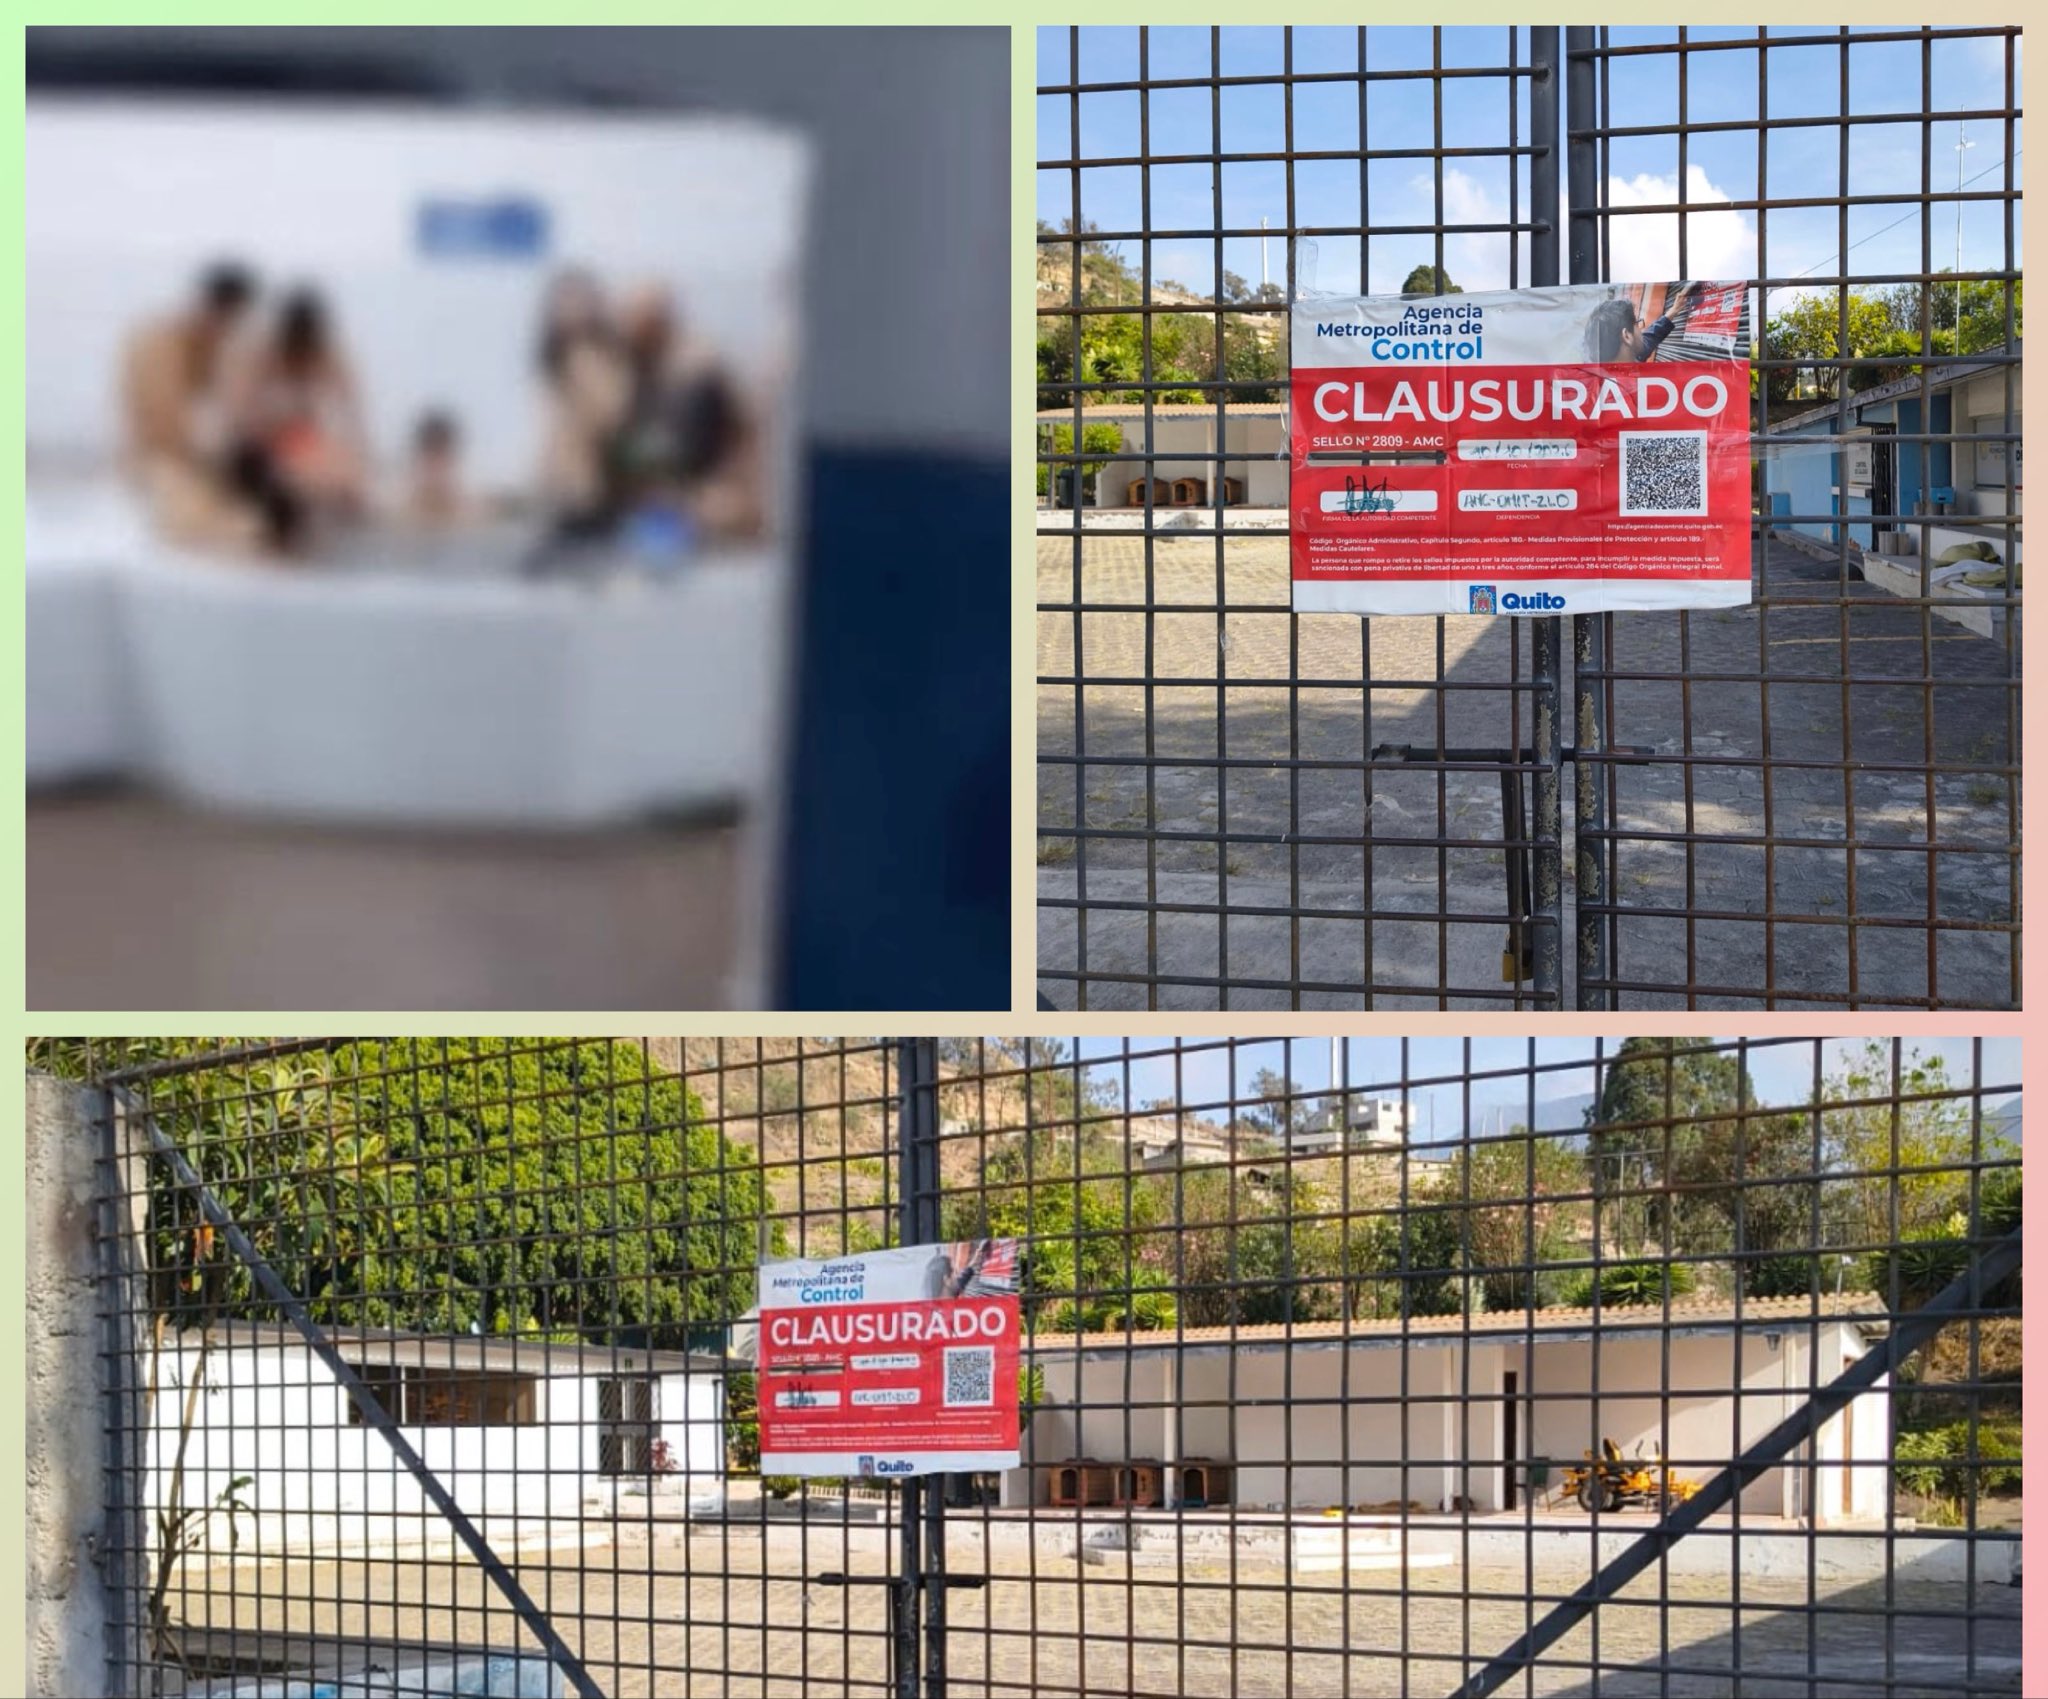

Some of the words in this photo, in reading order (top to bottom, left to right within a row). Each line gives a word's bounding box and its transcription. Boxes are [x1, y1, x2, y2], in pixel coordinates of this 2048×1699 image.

[1403, 303, 1483, 322] Agencia
[1317, 319, 1452, 339] Metropolitana
[1458, 320, 1483, 335] de
[1371, 336, 1482, 361] Control
[1313, 376, 1728, 422] CLAUSURADO
[1313, 436, 1352, 447] SELLO
[1372, 436, 1403, 447] 2809
[1413, 436, 1444, 446] AMC
[1557, 535, 1603, 543] Provisionales
[1501, 592, 1565, 609] Quito
[820, 1261, 865, 1275] Agencia
[850, 1273, 865, 1283] de
[801, 1284, 864, 1303] Control
[770, 1306, 1007, 1346] CLAUSURADO
[877, 1460, 914, 1473] Quito
